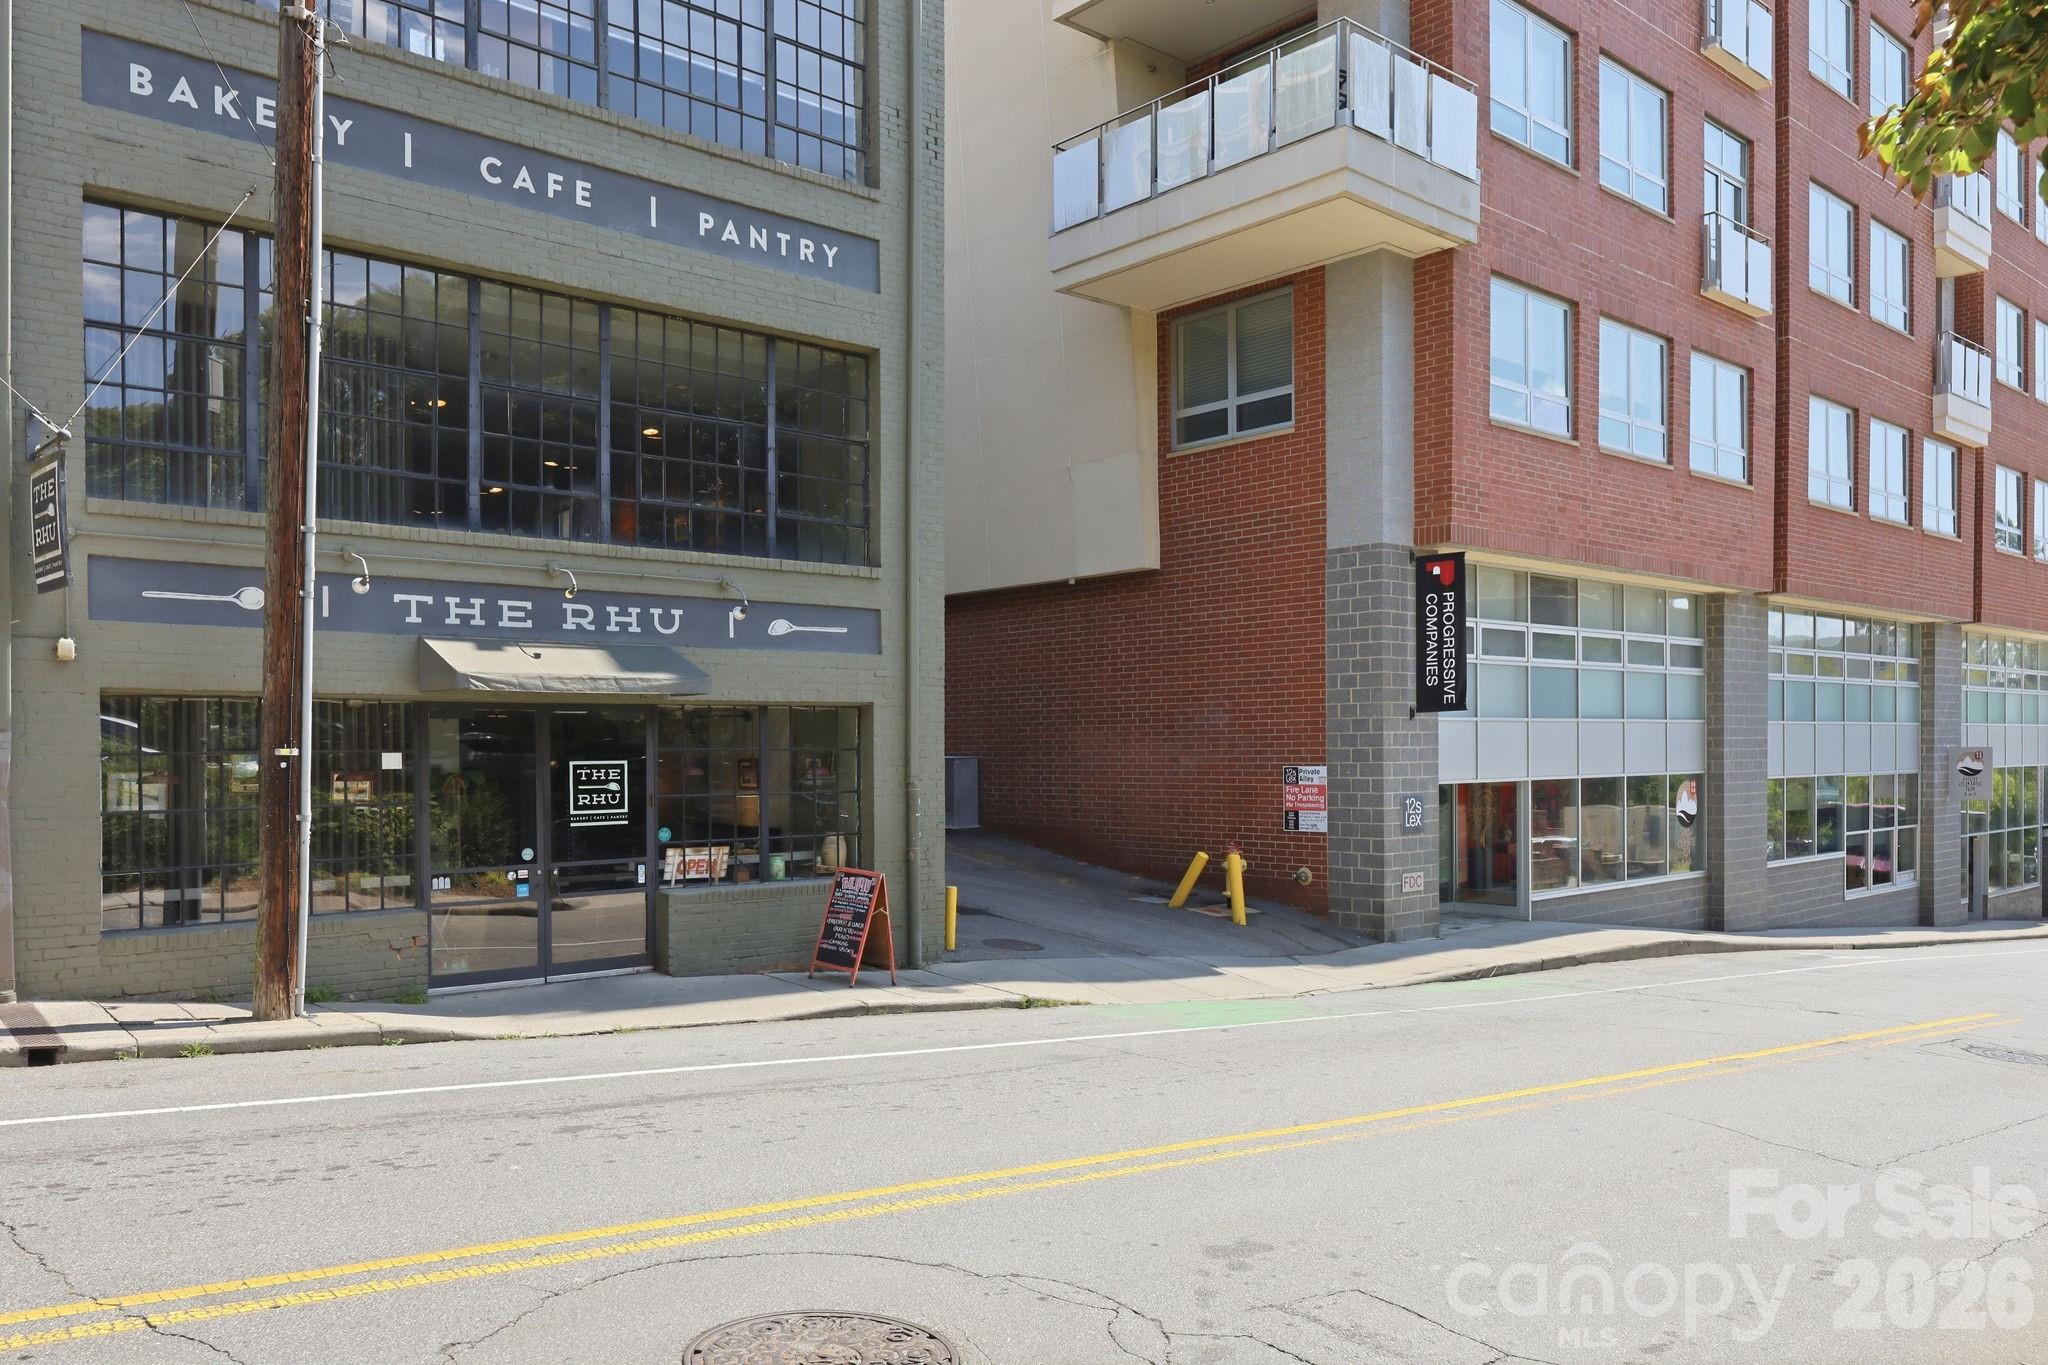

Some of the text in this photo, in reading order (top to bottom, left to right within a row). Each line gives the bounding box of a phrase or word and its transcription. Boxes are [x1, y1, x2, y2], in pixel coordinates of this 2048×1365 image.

[129, 62, 839, 268] BAKEY CAFE PANTRY
[33, 478, 56, 504] THE
[35, 521, 57, 548] RHU
[393, 593, 684, 636] THE RHU
[1425, 592, 1439, 687] COMPANIES
[1442, 591, 1456, 705] PROGRESSIVE
[576, 769, 621, 781] THE
[1298, 768, 1321, 776] Private
[1299, 775, 1315, 783] Alley
[1285, 785, 1319, 794] Fire Lane
[577, 793, 621, 805] RHU
[1297, 793, 1325, 803] Parking
[1405, 797, 1422, 814] 12s
[1405, 811, 1422, 827] Lex
[1403, 875, 1422, 889] FDC
